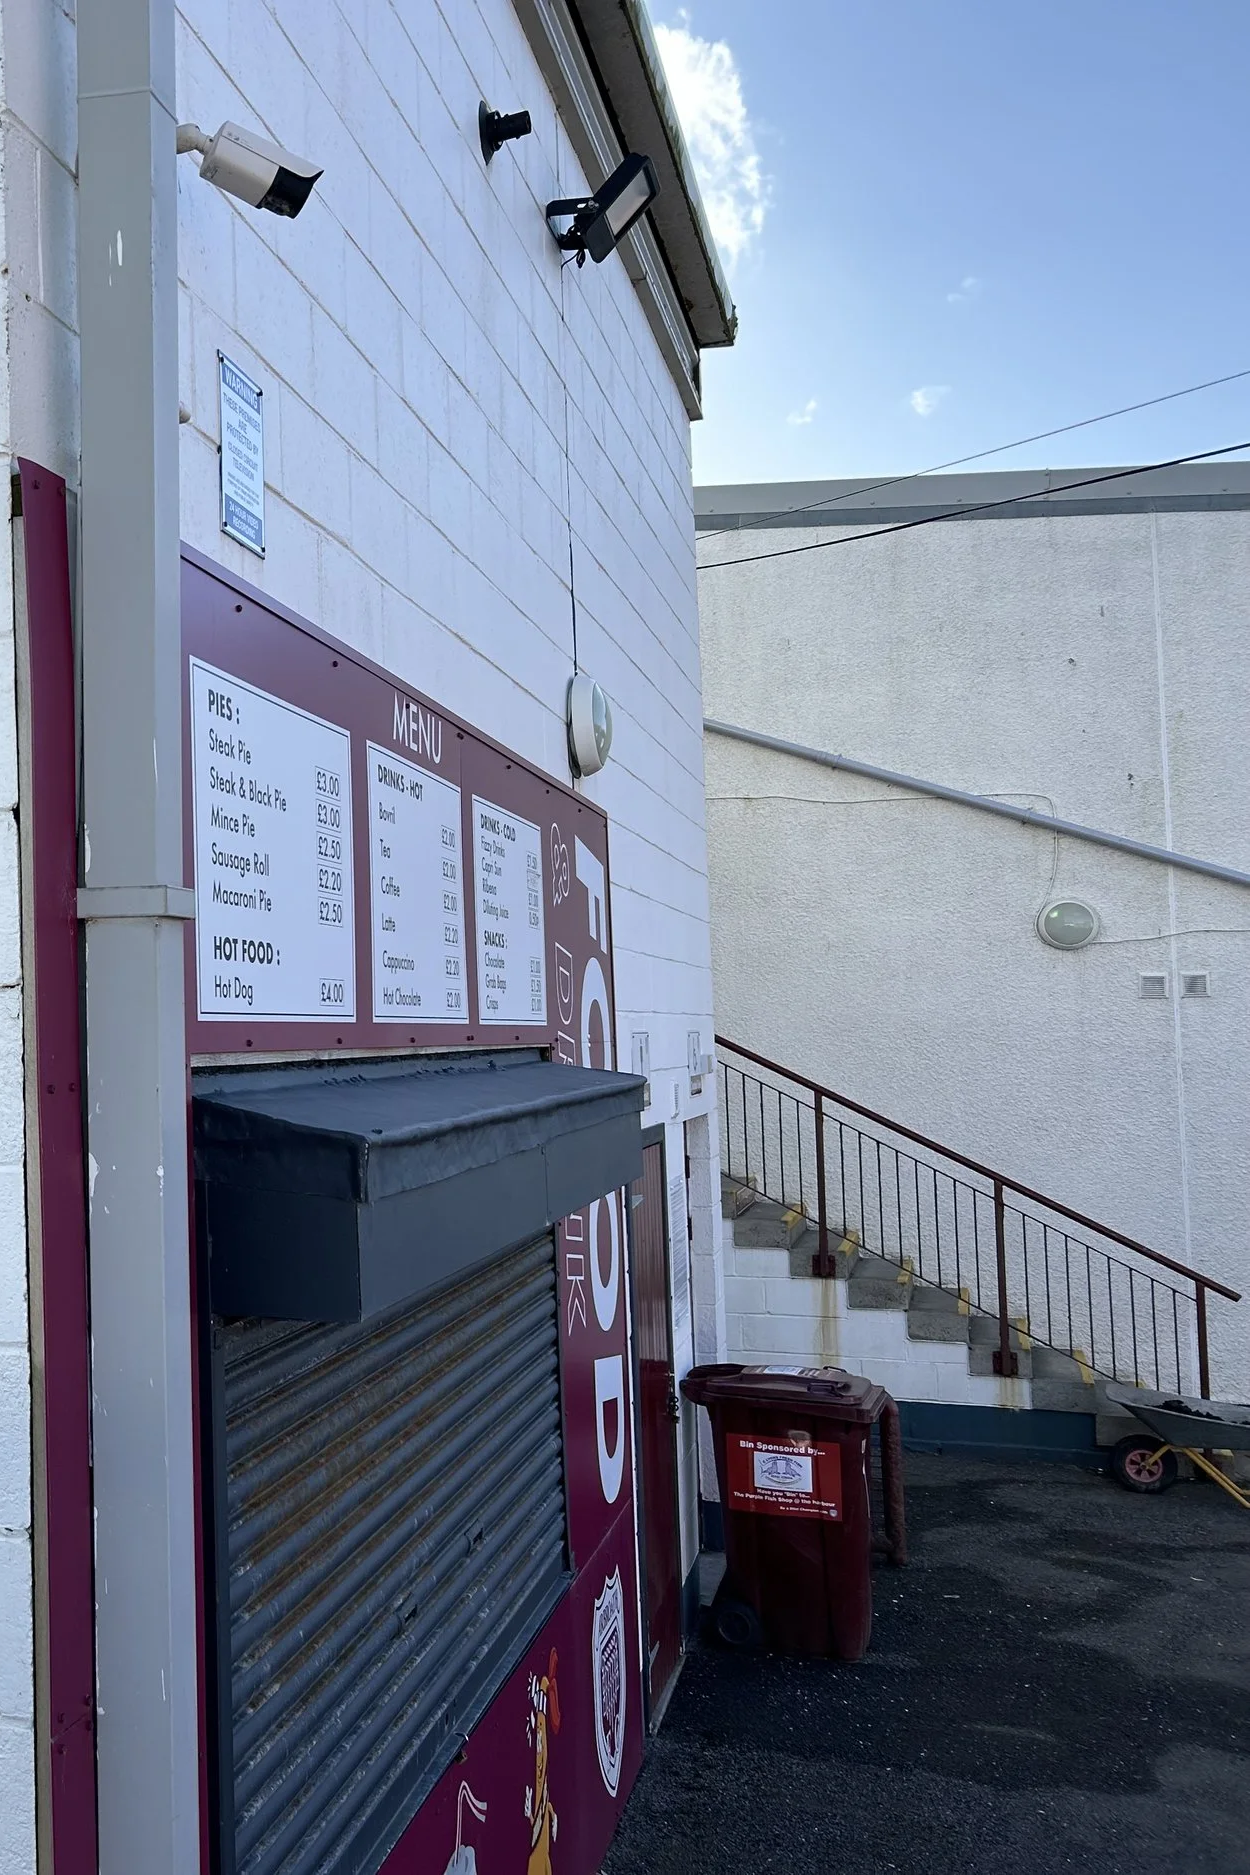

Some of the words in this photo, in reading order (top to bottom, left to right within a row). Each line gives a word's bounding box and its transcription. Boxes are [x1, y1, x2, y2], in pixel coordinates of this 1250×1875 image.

[225, 366, 258, 409] WARNING
[227, 421, 252, 451] PROTECTED
[393, 692, 442, 764] MENU
[209, 728, 235, 759] Steak
[238, 740, 251, 765] Pie
[210, 766, 236, 796] Steak
[239, 776, 246, 799] &
[249, 780, 272, 807] Black
[274, 789, 287, 811] Pie
[317, 771, 340, 797] £3.00
[378, 764, 405, 793] DRINKS
[410, 779, 423, 802] HOT
[211, 804, 239, 833] Mince
[242, 814, 255, 837] Pie
[317, 804, 340, 828] £3.00
[379, 802, 395, 824] Bovril
[441, 828, 456, 848] £2.00
[480, 813, 500, 835] DRINKS
[503, 823, 516, 842] COLD
[318, 836, 341, 860] £2.50
[380, 839, 391, 859] Tea
[480, 835, 492, 856] Fizzy
[493, 839, 505, 858] Drinks
[211, 842, 250, 877] Sausage
[253, 853, 270, 876] Roll
[442, 860, 456, 880] £2.00
[481, 856, 494, 877] Capri
[319, 868, 342, 892] £2.20
[381, 876, 400, 898] Coffee
[213, 880, 257, 911] Macaroni
[259, 889, 271, 912] Pie
[443, 893, 458, 912] £2.00
[319, 901, 342, 923] £2.50
[382, 912, 396, 932] Latte
[444, 926, 459, 944] £2.20
[484, 930, 505, 948] SNACKS
[214, 936, 238, 961] HOT
[242, 940, 273, 965] FOOD
[484, 952, 505, 968] Chocolate
[382, 950, 415, 975] Cappuccino
[445, 959, 460, 976] £2.20
[214, 975, 232, 998] Hot
[235, 977, 253, 1006] Dog
[321, 982, 343, 1003] £4.00
[383, 987, 394, 1005] Hot
[395, 987, 422, 1007] Chocolate
[446, 991, 461, 1008] £2.00
[739, 1440, 754, 1449] Bin
[756, 1441, 805, 1454] Sponsored
